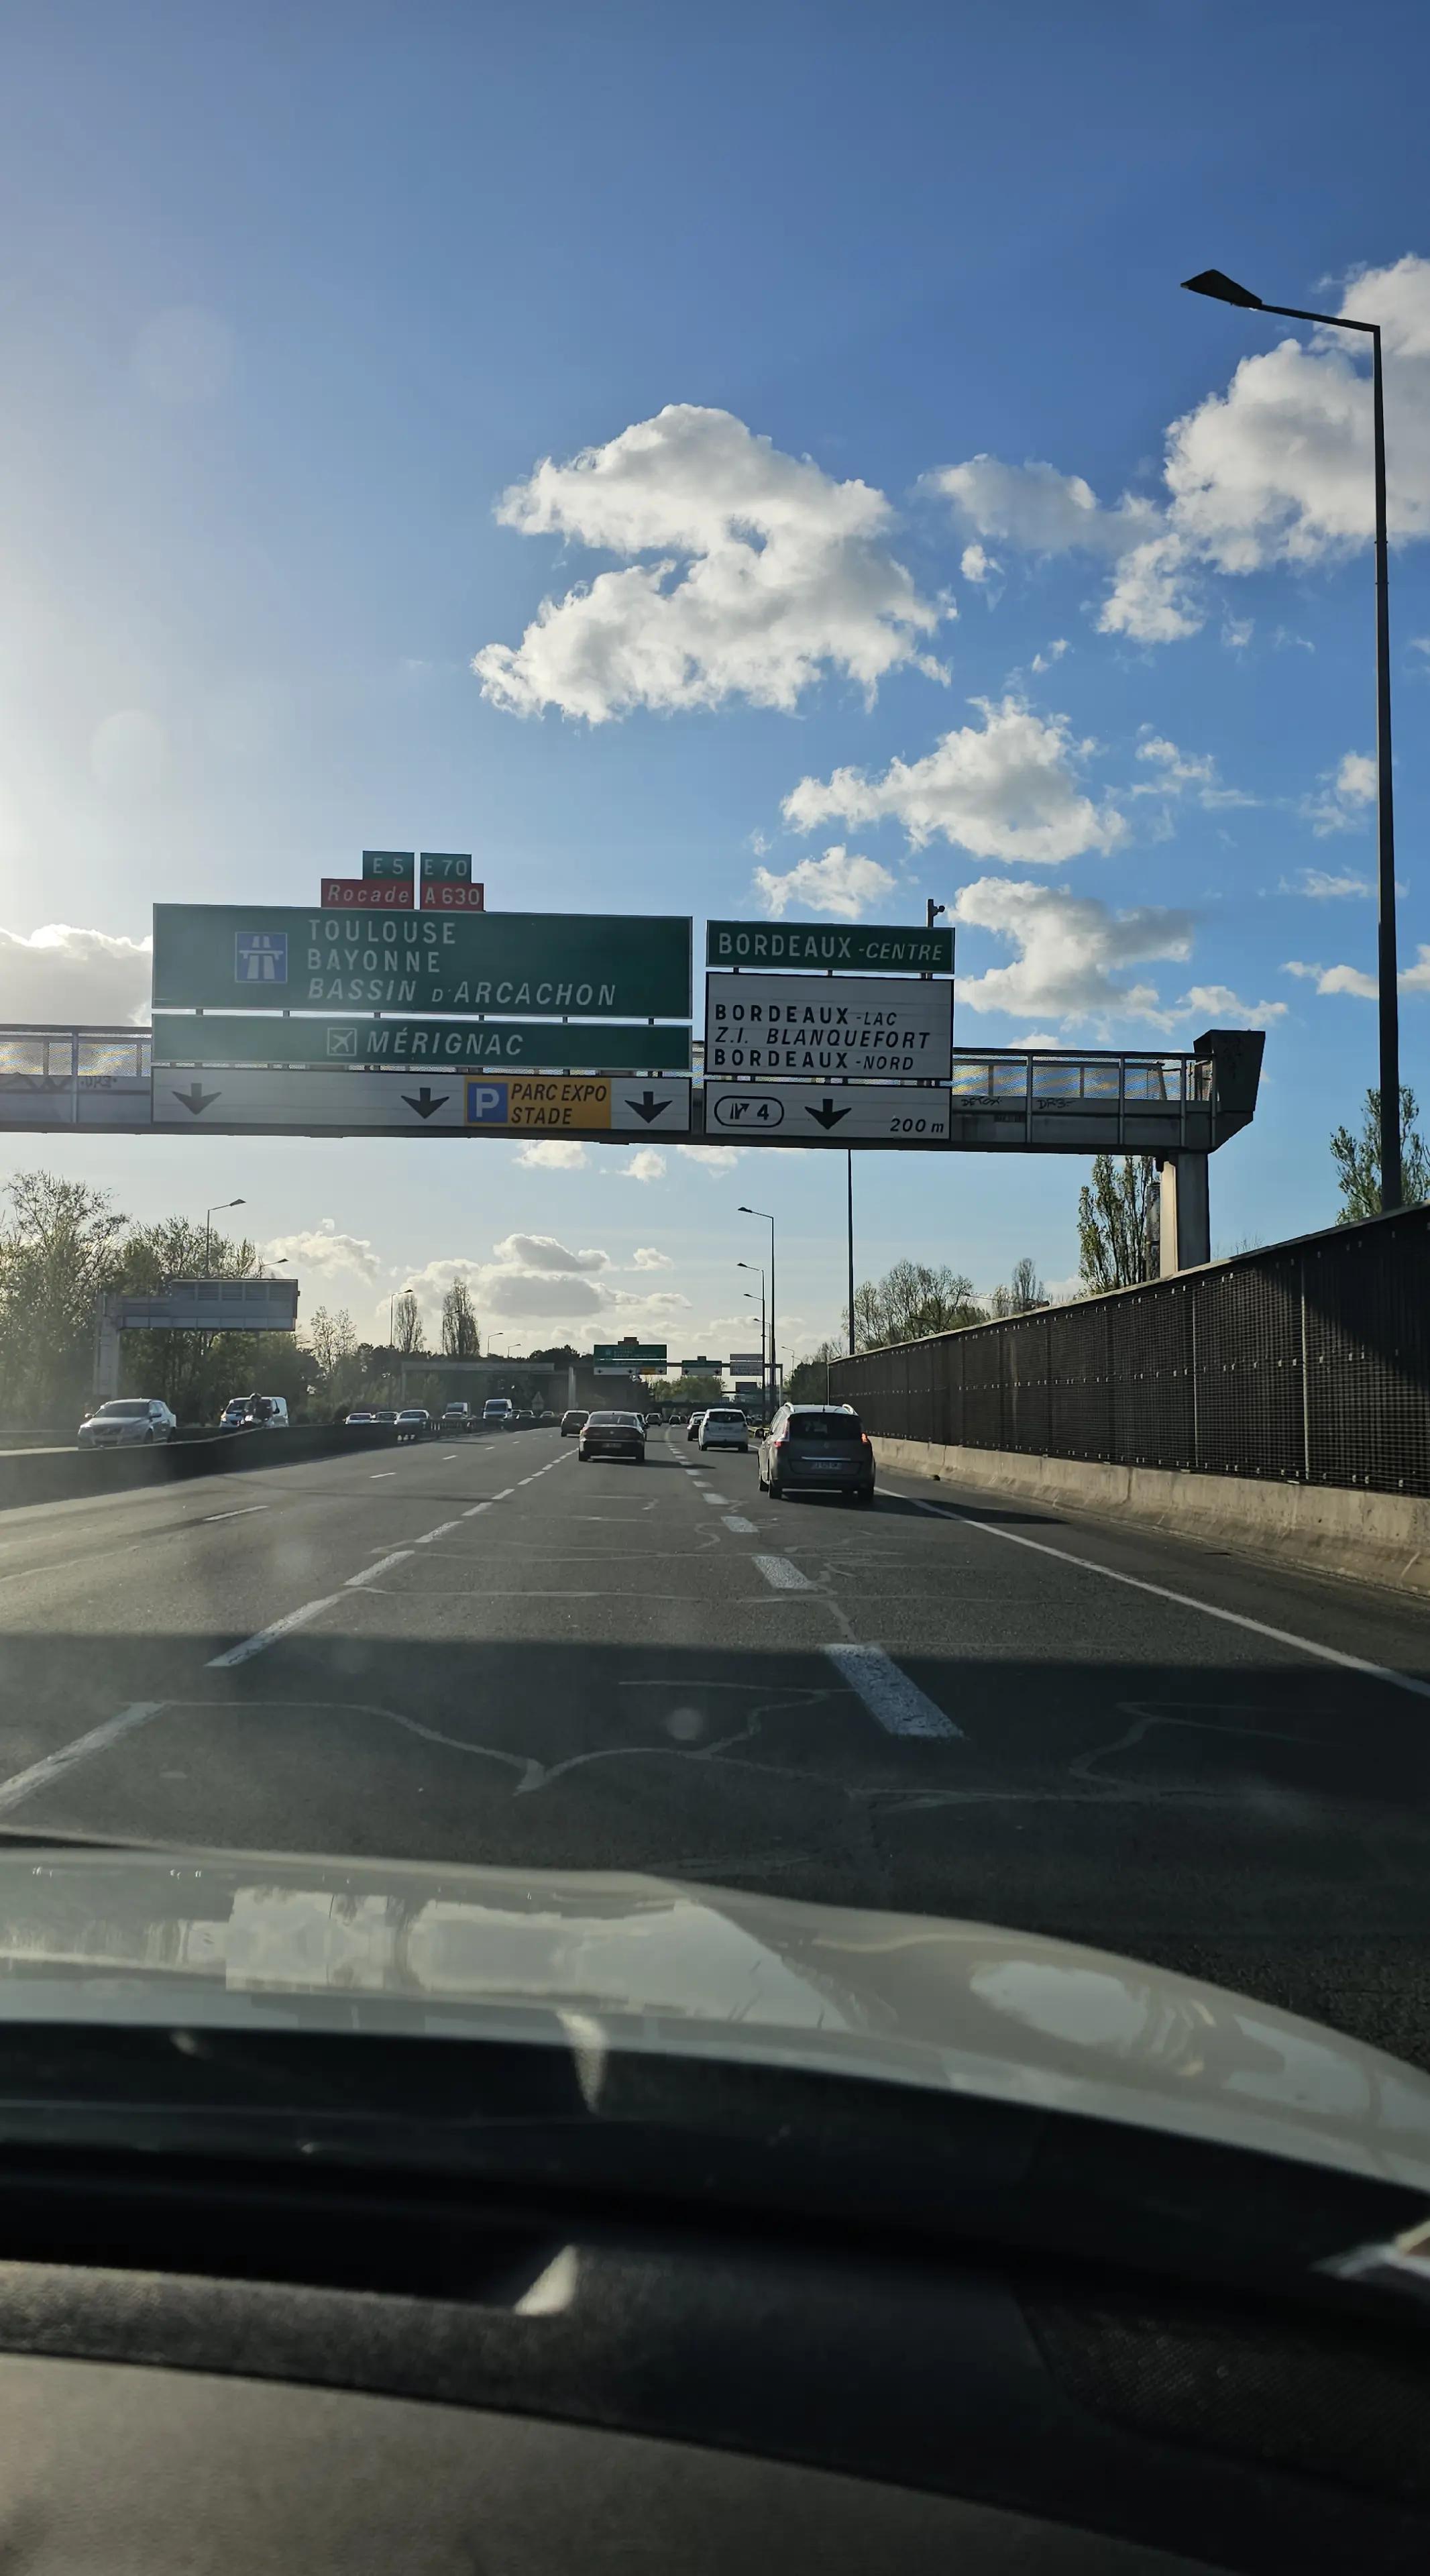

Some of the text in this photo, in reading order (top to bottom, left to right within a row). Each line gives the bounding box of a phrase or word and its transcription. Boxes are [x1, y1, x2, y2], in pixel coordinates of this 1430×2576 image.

[373, 858, 404, 875] E 5
[424, 859, 468, 876] E 70
[328, 884, 409, 903] Rocade
[309, 920, 455, 945] TOULOUSE
[308, 949, 440, 973] BAYONNE
[308, 978, 417, 1001] BASSIN
[366, 1026, 524, 1055] MÉRIGNAC
[715, 1027, 930, 1049] Z.I. BLANQUEFORT
[510, 1083, 606, 1102] PARC EXPO
[476, 1088, 500, 1118] P
[757, 1104, 769, 1121] 4
[511, 1107, 572, 1125] STADE
[890, 1118, 944, 1134] 200 m
